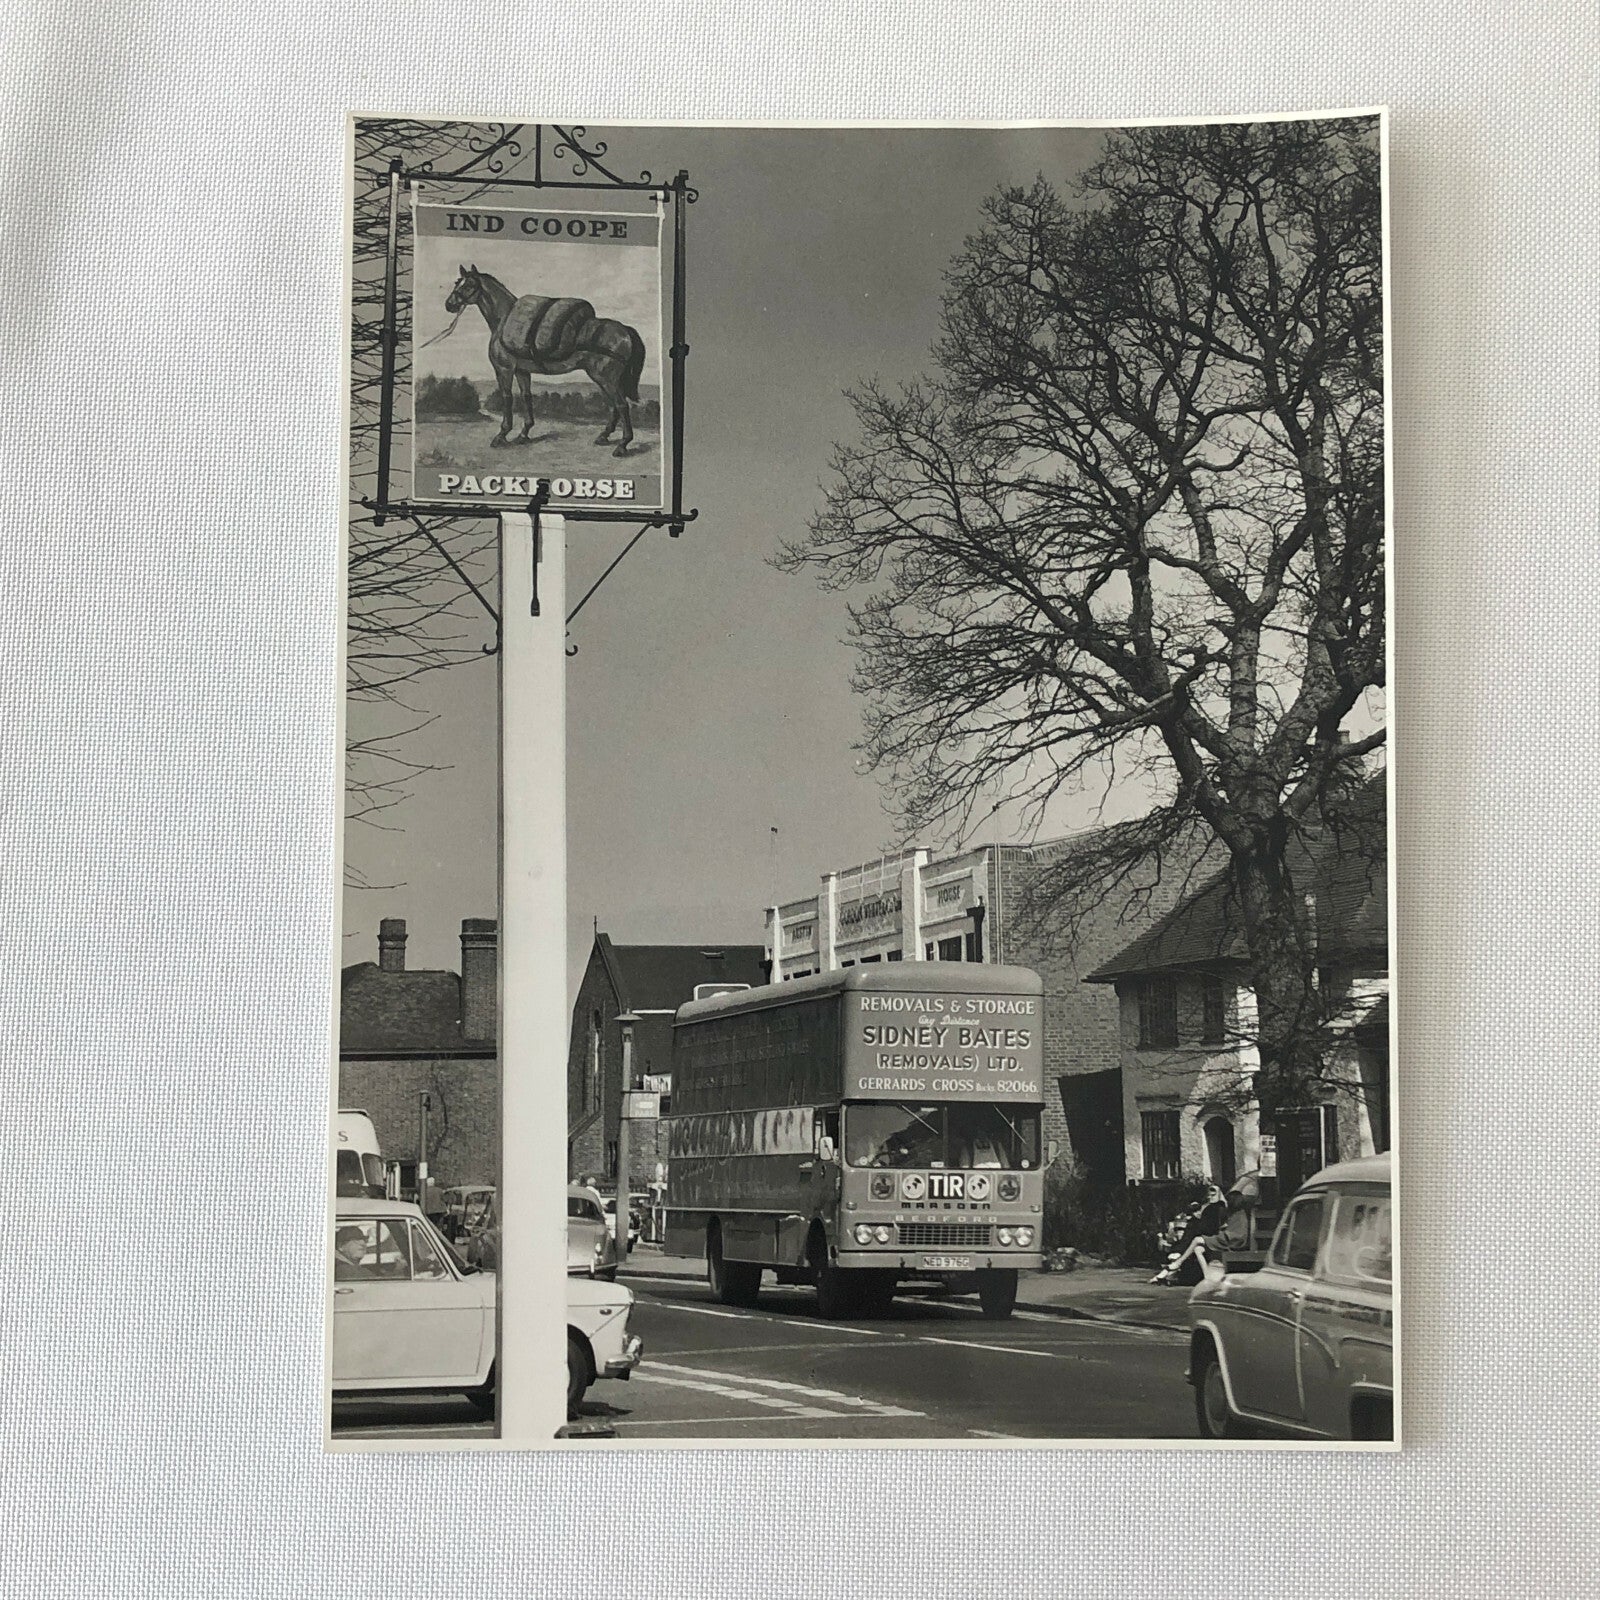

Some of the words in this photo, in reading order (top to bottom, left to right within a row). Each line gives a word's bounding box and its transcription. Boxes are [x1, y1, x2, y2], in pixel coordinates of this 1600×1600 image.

[446, 213, 505, 233] IND
[520, 216, 628, 239] COOPE
[860, 996, 944, 1013] REMOVALS
[950, 999, 962, 1013] &
[966, 1000, 1035, 1015] STORAGE
[862, 1025, 949, 1047] SIDNEY
[958, 1028, 1032, 1050] BATES
[876, 1052, 979, 1073] (REMOVALS)
[987, 1056, 1024, 1072] LTD.
[858, 1077, 927, 1091] GERRARDS
[932, 1078, 975, 1092] CROSS
[929, 1175, 964, 1197] TIR
[895, 1215, 998, 1223] BEDFORD
